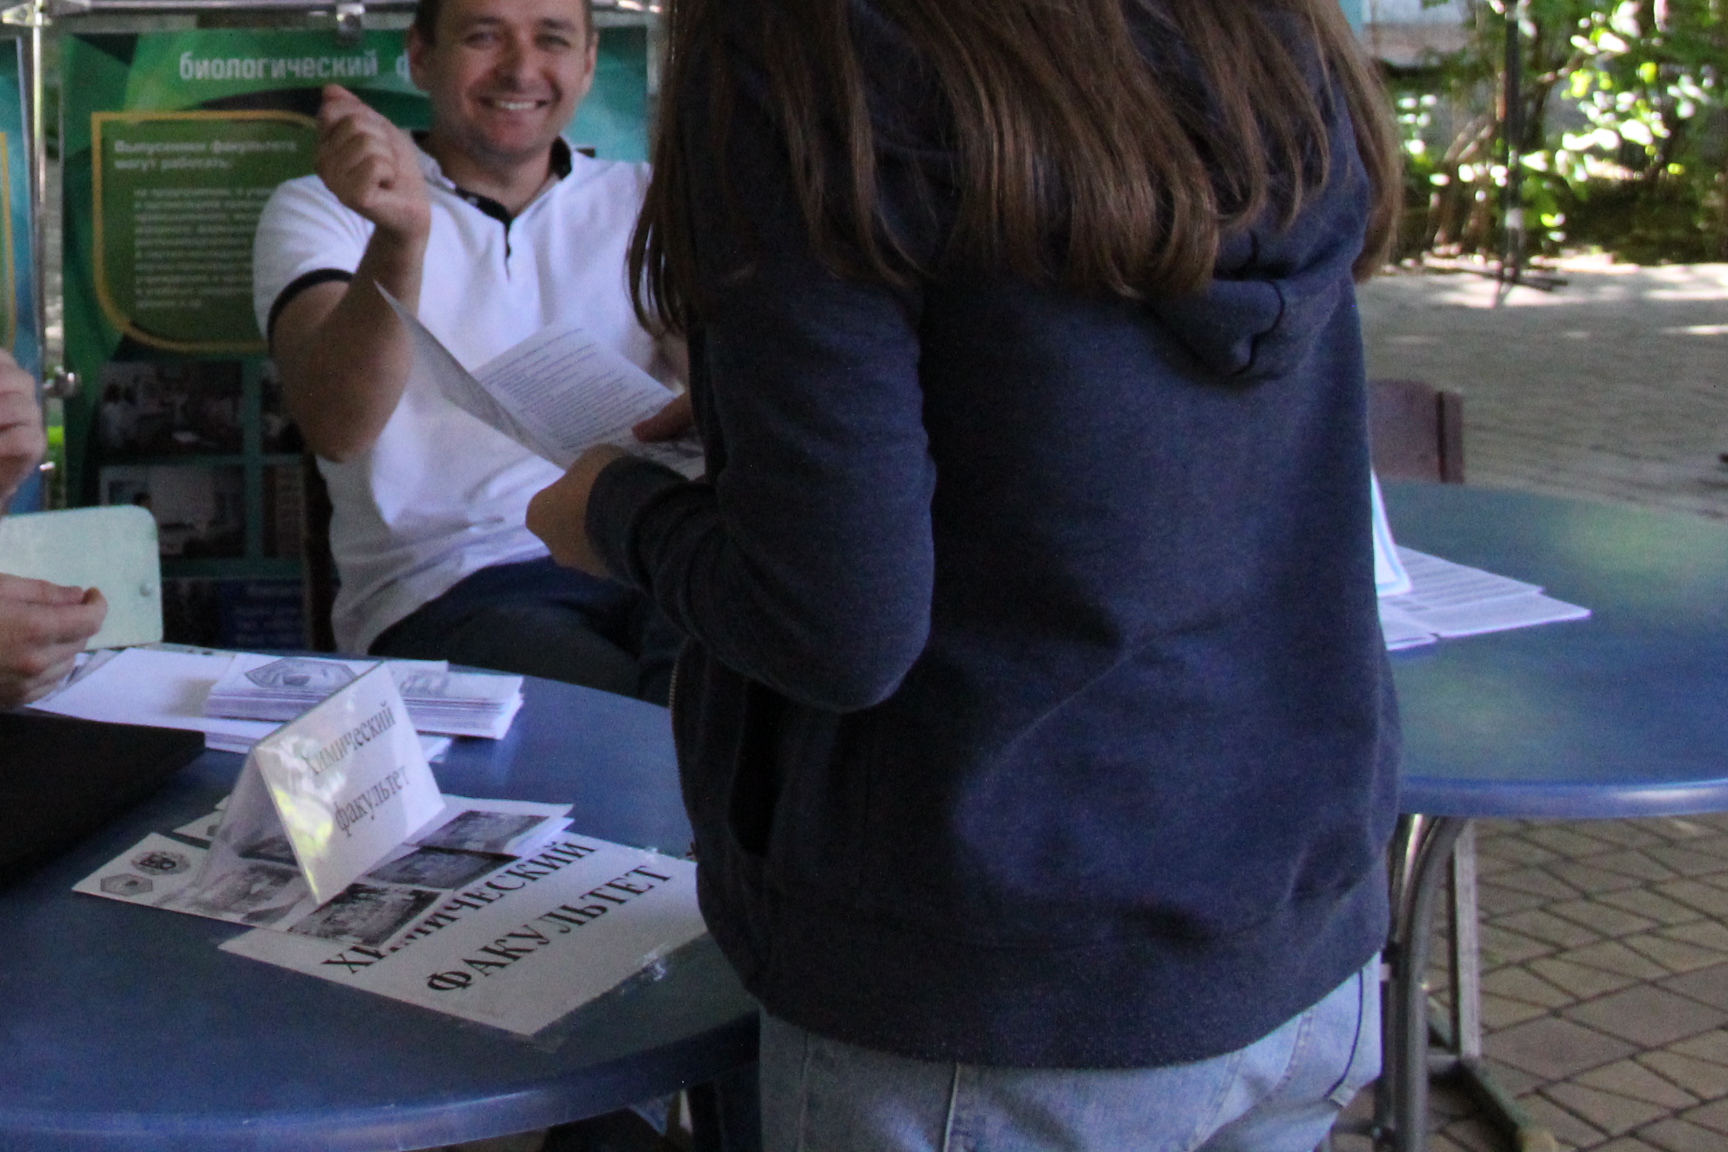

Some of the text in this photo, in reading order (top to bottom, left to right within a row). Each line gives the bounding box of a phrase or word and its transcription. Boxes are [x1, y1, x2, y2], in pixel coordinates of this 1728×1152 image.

[179, 50, 378, 82] биологический
[333, 765, 412, 837] факультет
[427, 864, 672, 992] ФАКУЛЬТЕТ
